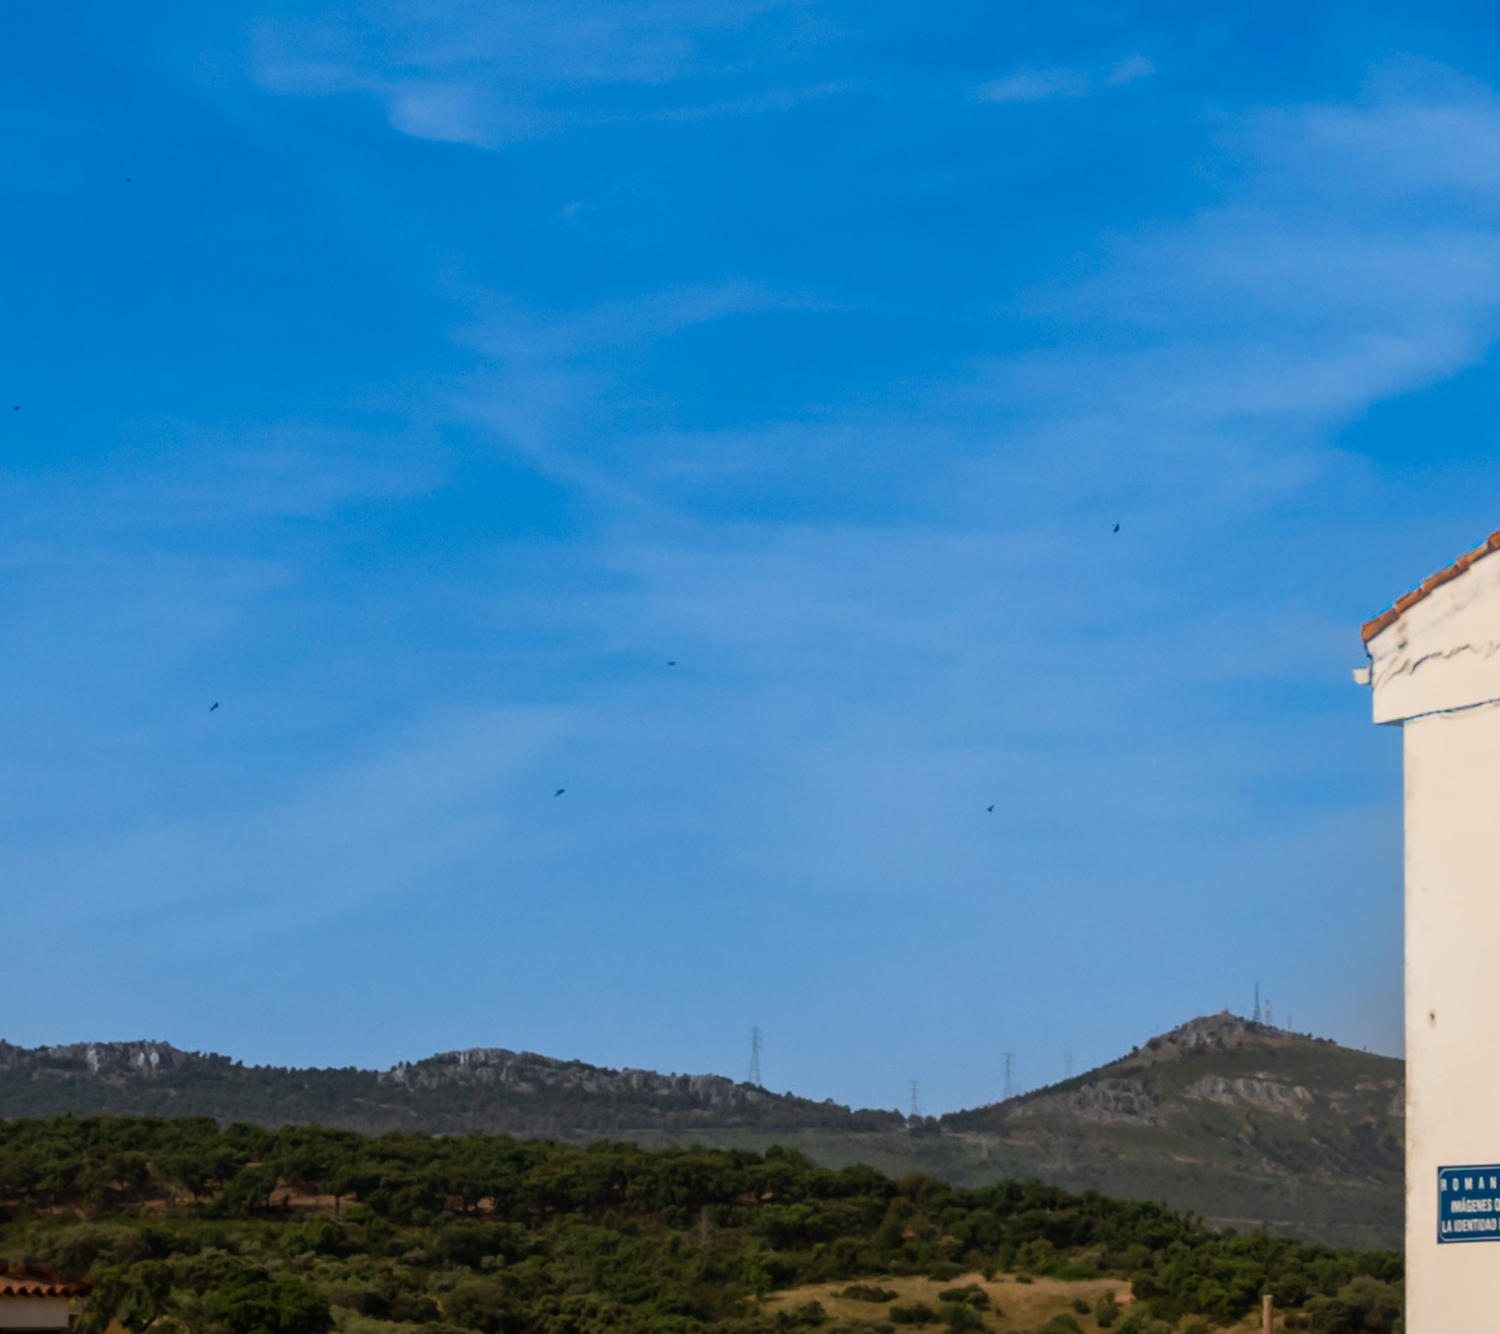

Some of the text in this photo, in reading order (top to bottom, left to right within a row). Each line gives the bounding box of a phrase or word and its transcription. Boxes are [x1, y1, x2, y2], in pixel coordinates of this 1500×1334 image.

[1451, 1197, 1493, 1213] IMÁGENES
[1442, 1220, 1452, 1233] LA
[1454, 1218, 1497, 1232] IDENTIDAD
